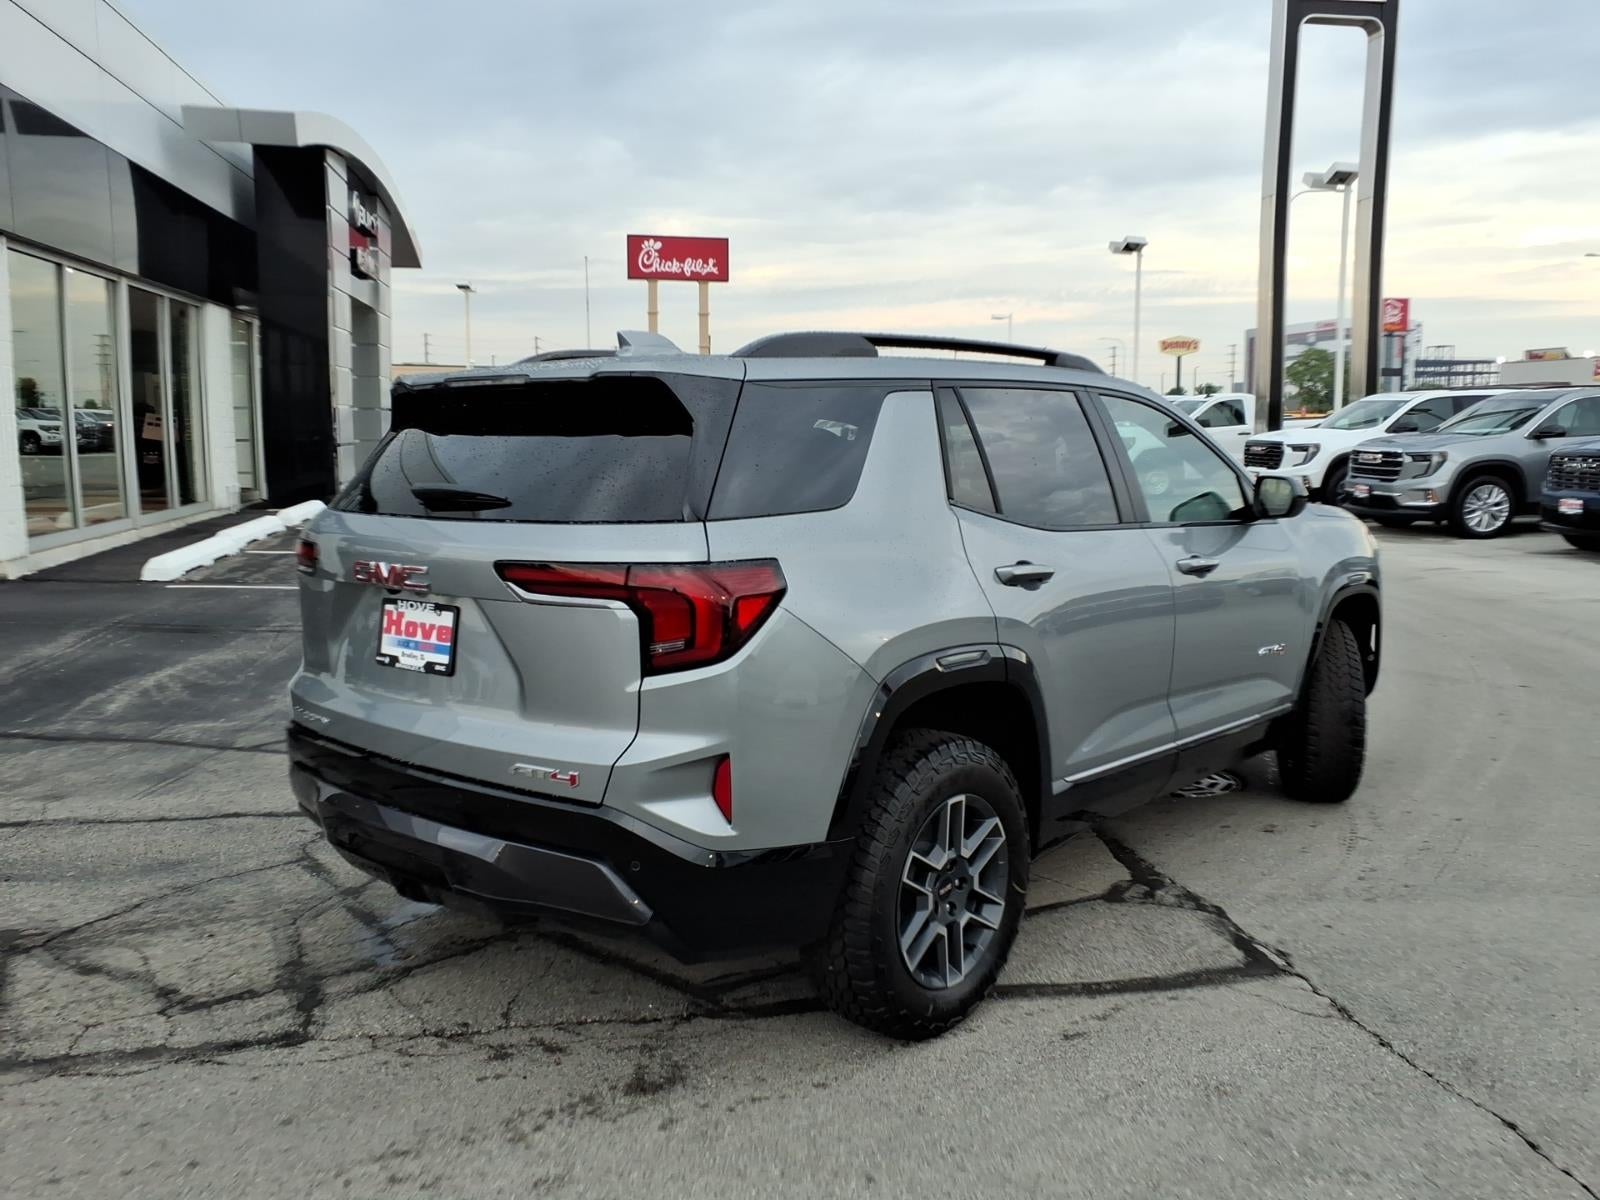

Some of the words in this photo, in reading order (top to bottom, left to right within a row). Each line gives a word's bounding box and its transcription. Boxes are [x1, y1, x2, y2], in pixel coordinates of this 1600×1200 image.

[353, 560, 431, 592] GMC
[397, 600, 436, 612] HOVE
[383, 609, 453, 643] Hove
